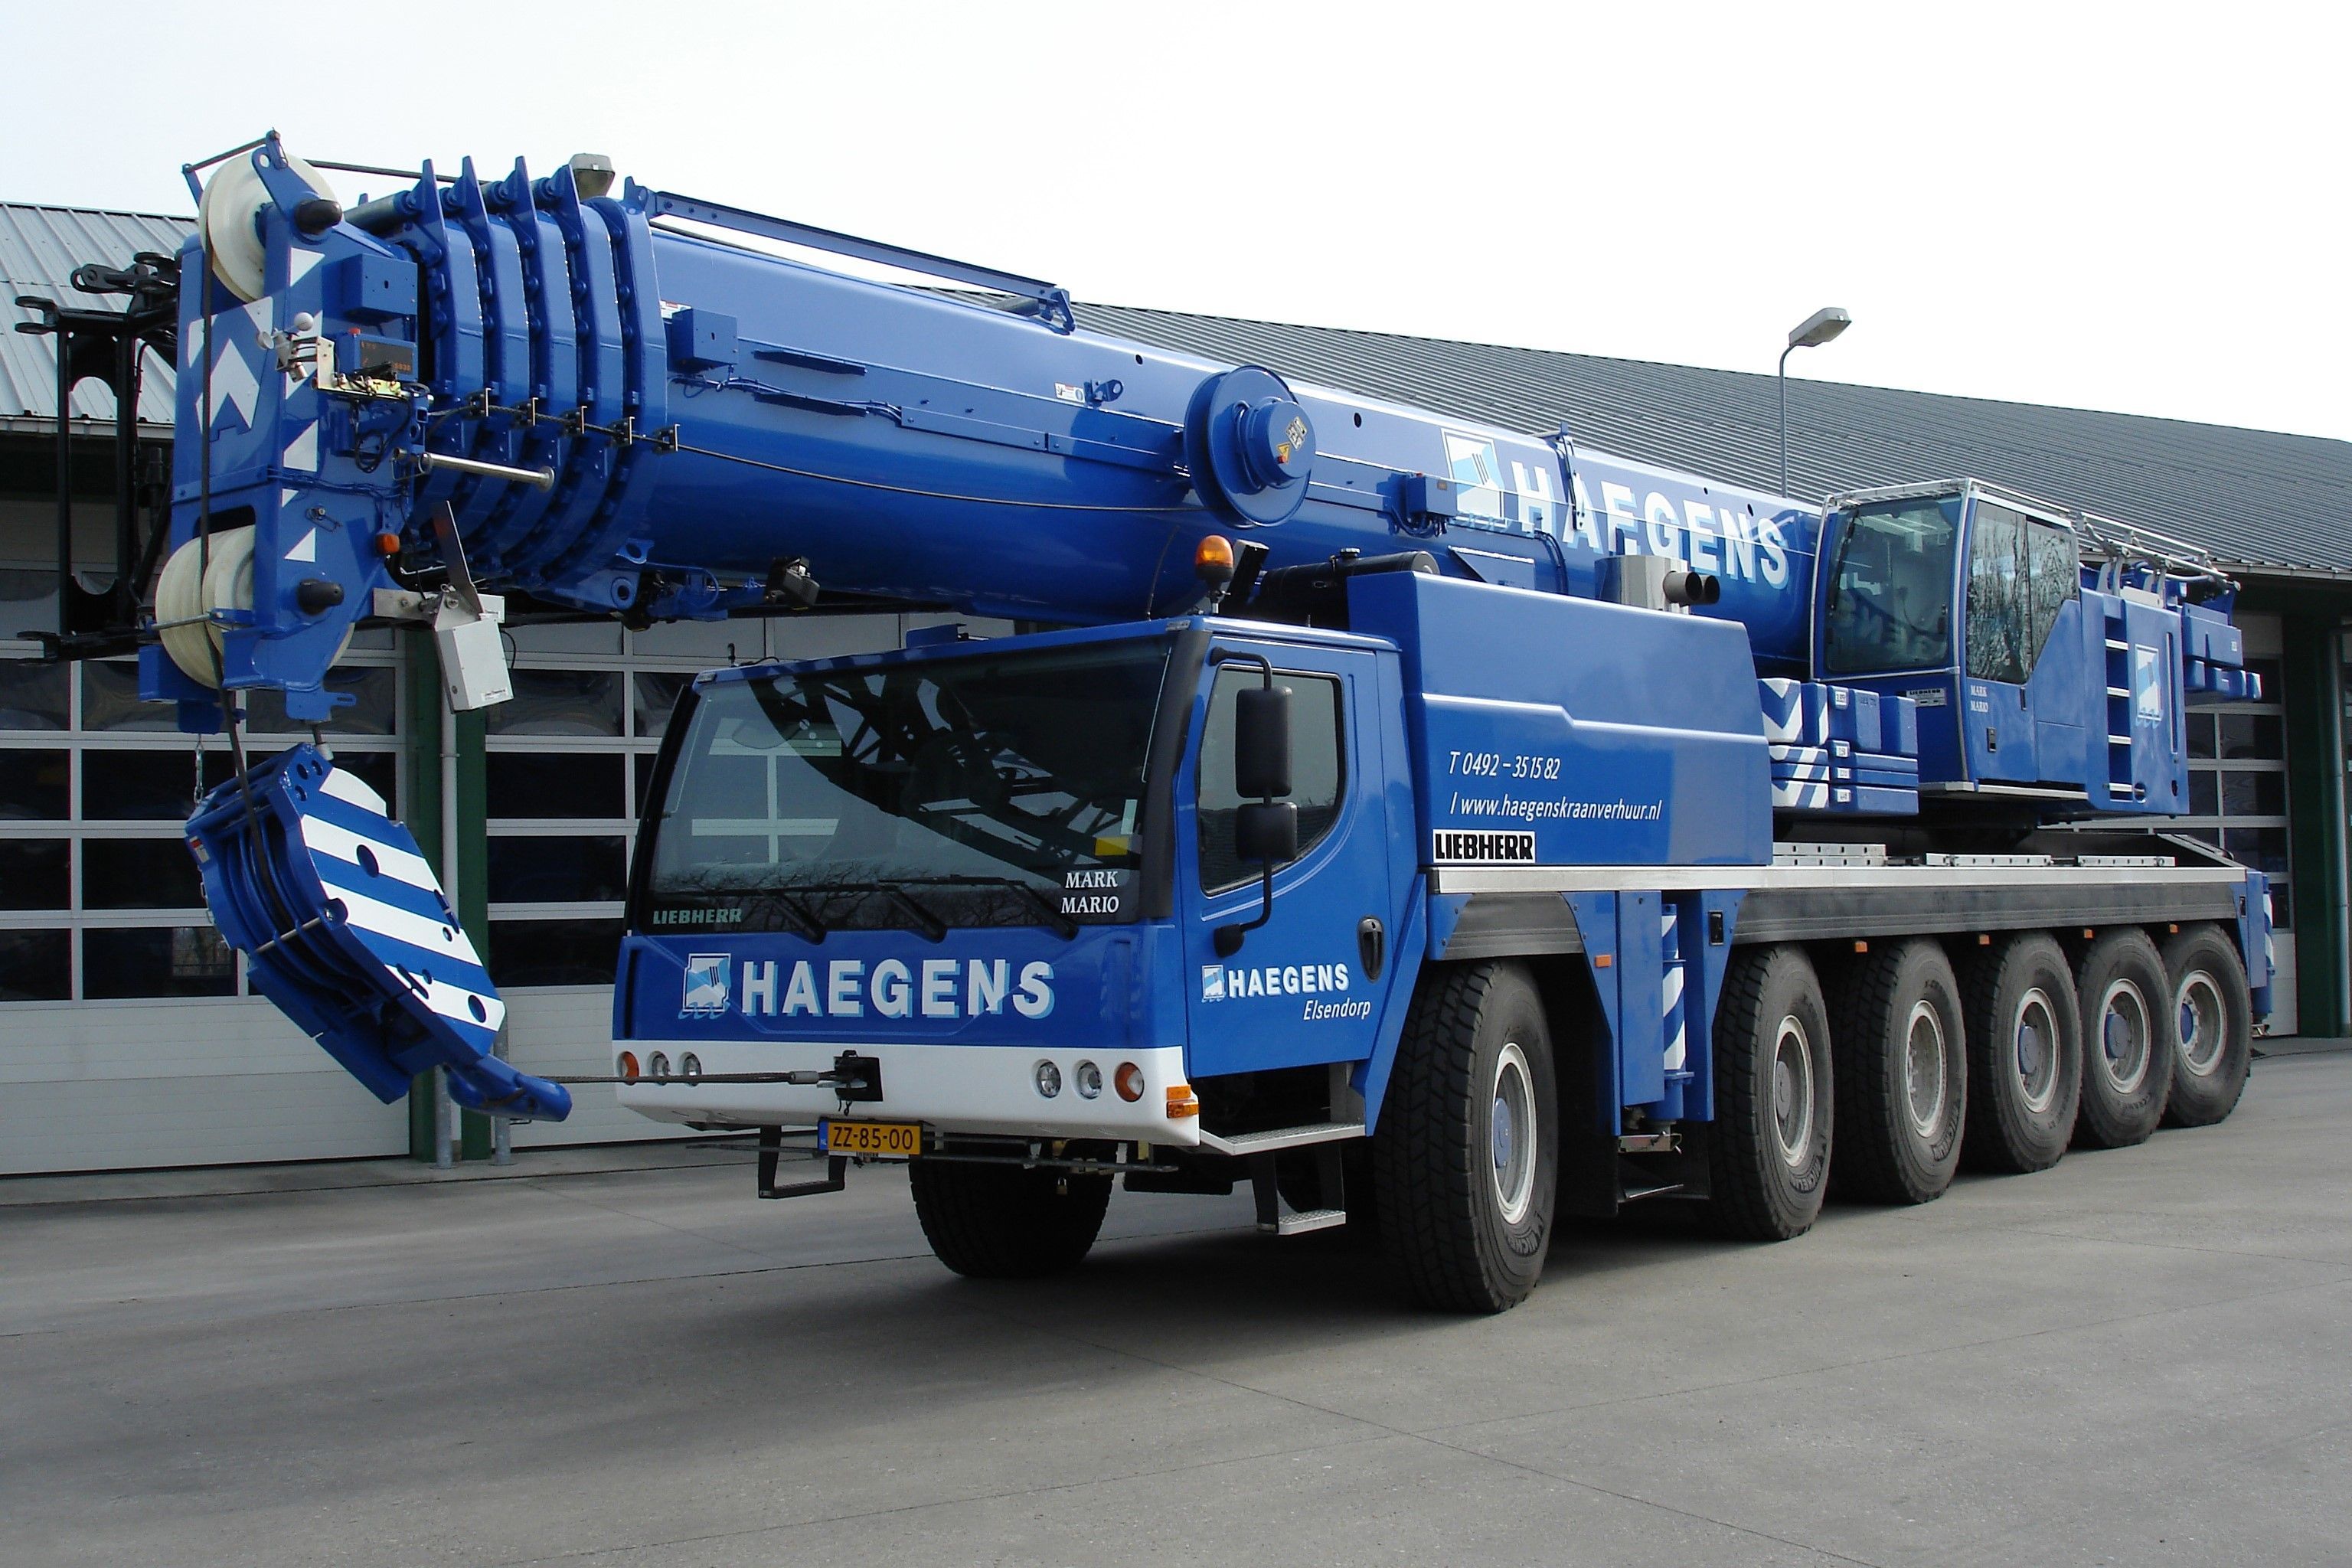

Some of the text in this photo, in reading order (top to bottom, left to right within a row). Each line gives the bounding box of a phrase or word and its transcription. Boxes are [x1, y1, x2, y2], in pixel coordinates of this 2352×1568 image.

[1511, 461, 1788, 590] HAEGENS
[1449, 751, 1460, 774] T
[1462, 753, 1500, 776] 0492
[1461, 794, 1662, 822] www.haegenskraanverhuur.nl
[1436, 834, 1533, 860] LIEBHERR
[1065, 871, 1118, 888] MARK
[653, 908, 742, 924] LIEBHERR
[1061, 896, 1119, 913] MARIO
[742, 959, 1054, 1019] HAEGENS
[1228, 963, 1350, 998] HAEGENS
[1304, 997, 1370, 1021] Elsendorp
[833, 1126, 913, 1150] ZZ-85-00
